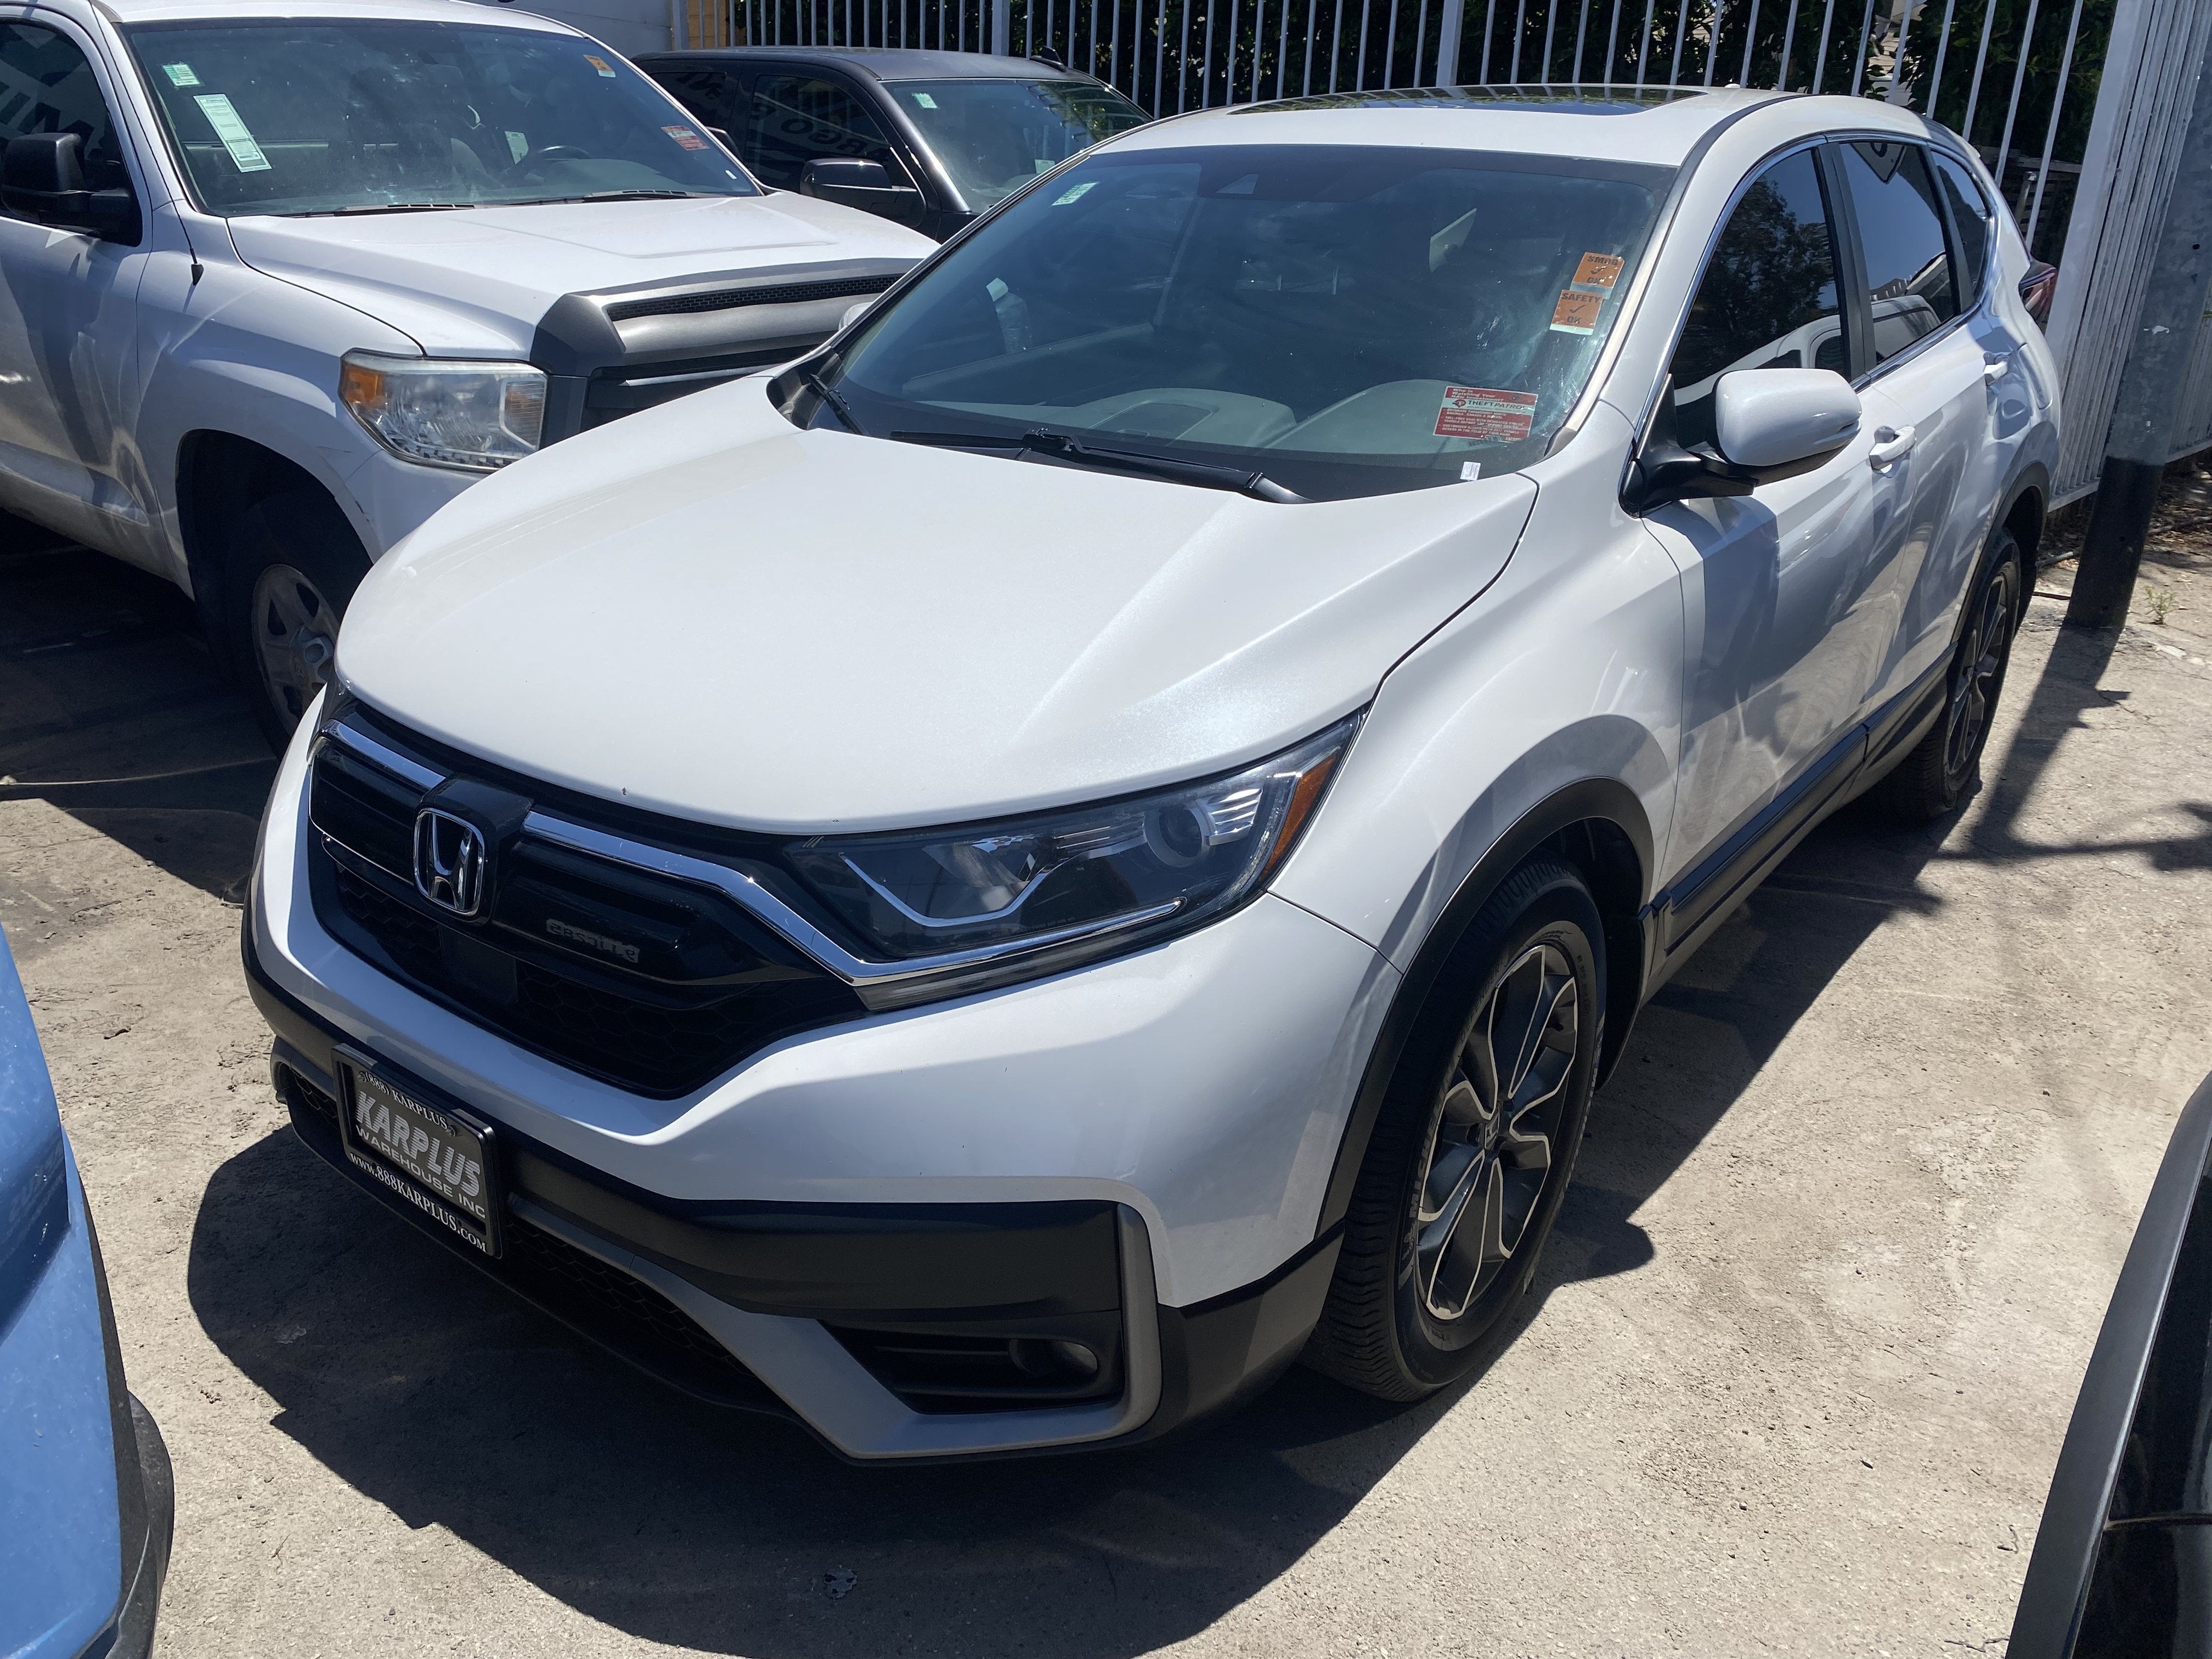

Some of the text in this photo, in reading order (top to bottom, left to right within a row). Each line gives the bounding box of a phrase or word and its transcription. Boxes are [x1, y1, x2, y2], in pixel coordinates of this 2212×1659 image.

[1587, 256, 1618, 266] SMOG
[1561, 293, 1601, 303] SAFETY
[366, 1071, 448, 1130] (888) KARPLUS
[356, 1091, 481, 1197] KARPLUS
[356, 1124, 486, 1219] WAREHOUSE INC
